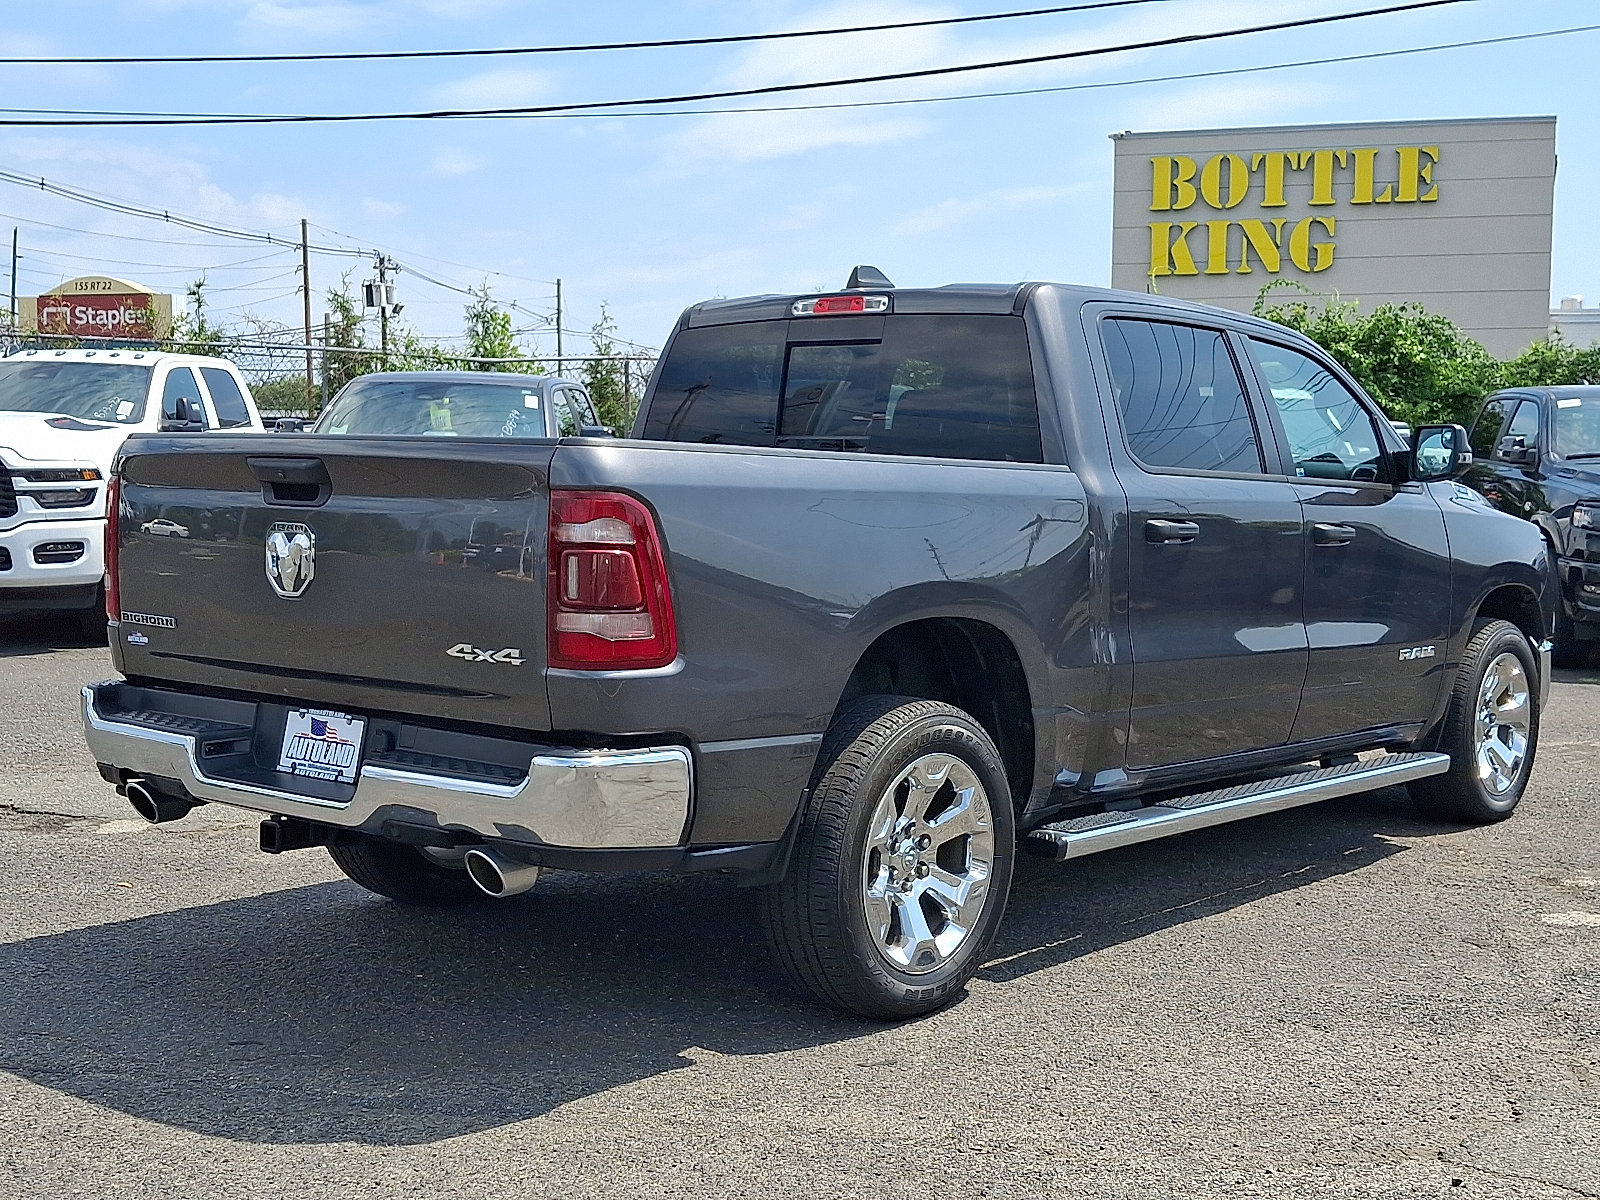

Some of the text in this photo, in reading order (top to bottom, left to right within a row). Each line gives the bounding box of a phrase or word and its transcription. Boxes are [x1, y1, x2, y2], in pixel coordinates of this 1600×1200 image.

[1148, 146, 1440, 212] BOTTLE
[1147, 216, 1337, 276] KING
[74, 281, 112, 291] 155 RT 22
[74, 305, 147, 330] Staples
[121, 611, 175, 628] BIGHORN
[1399, 645, 1436, 661] RAM
[287, 736, 355, 768] AUTOLAND
